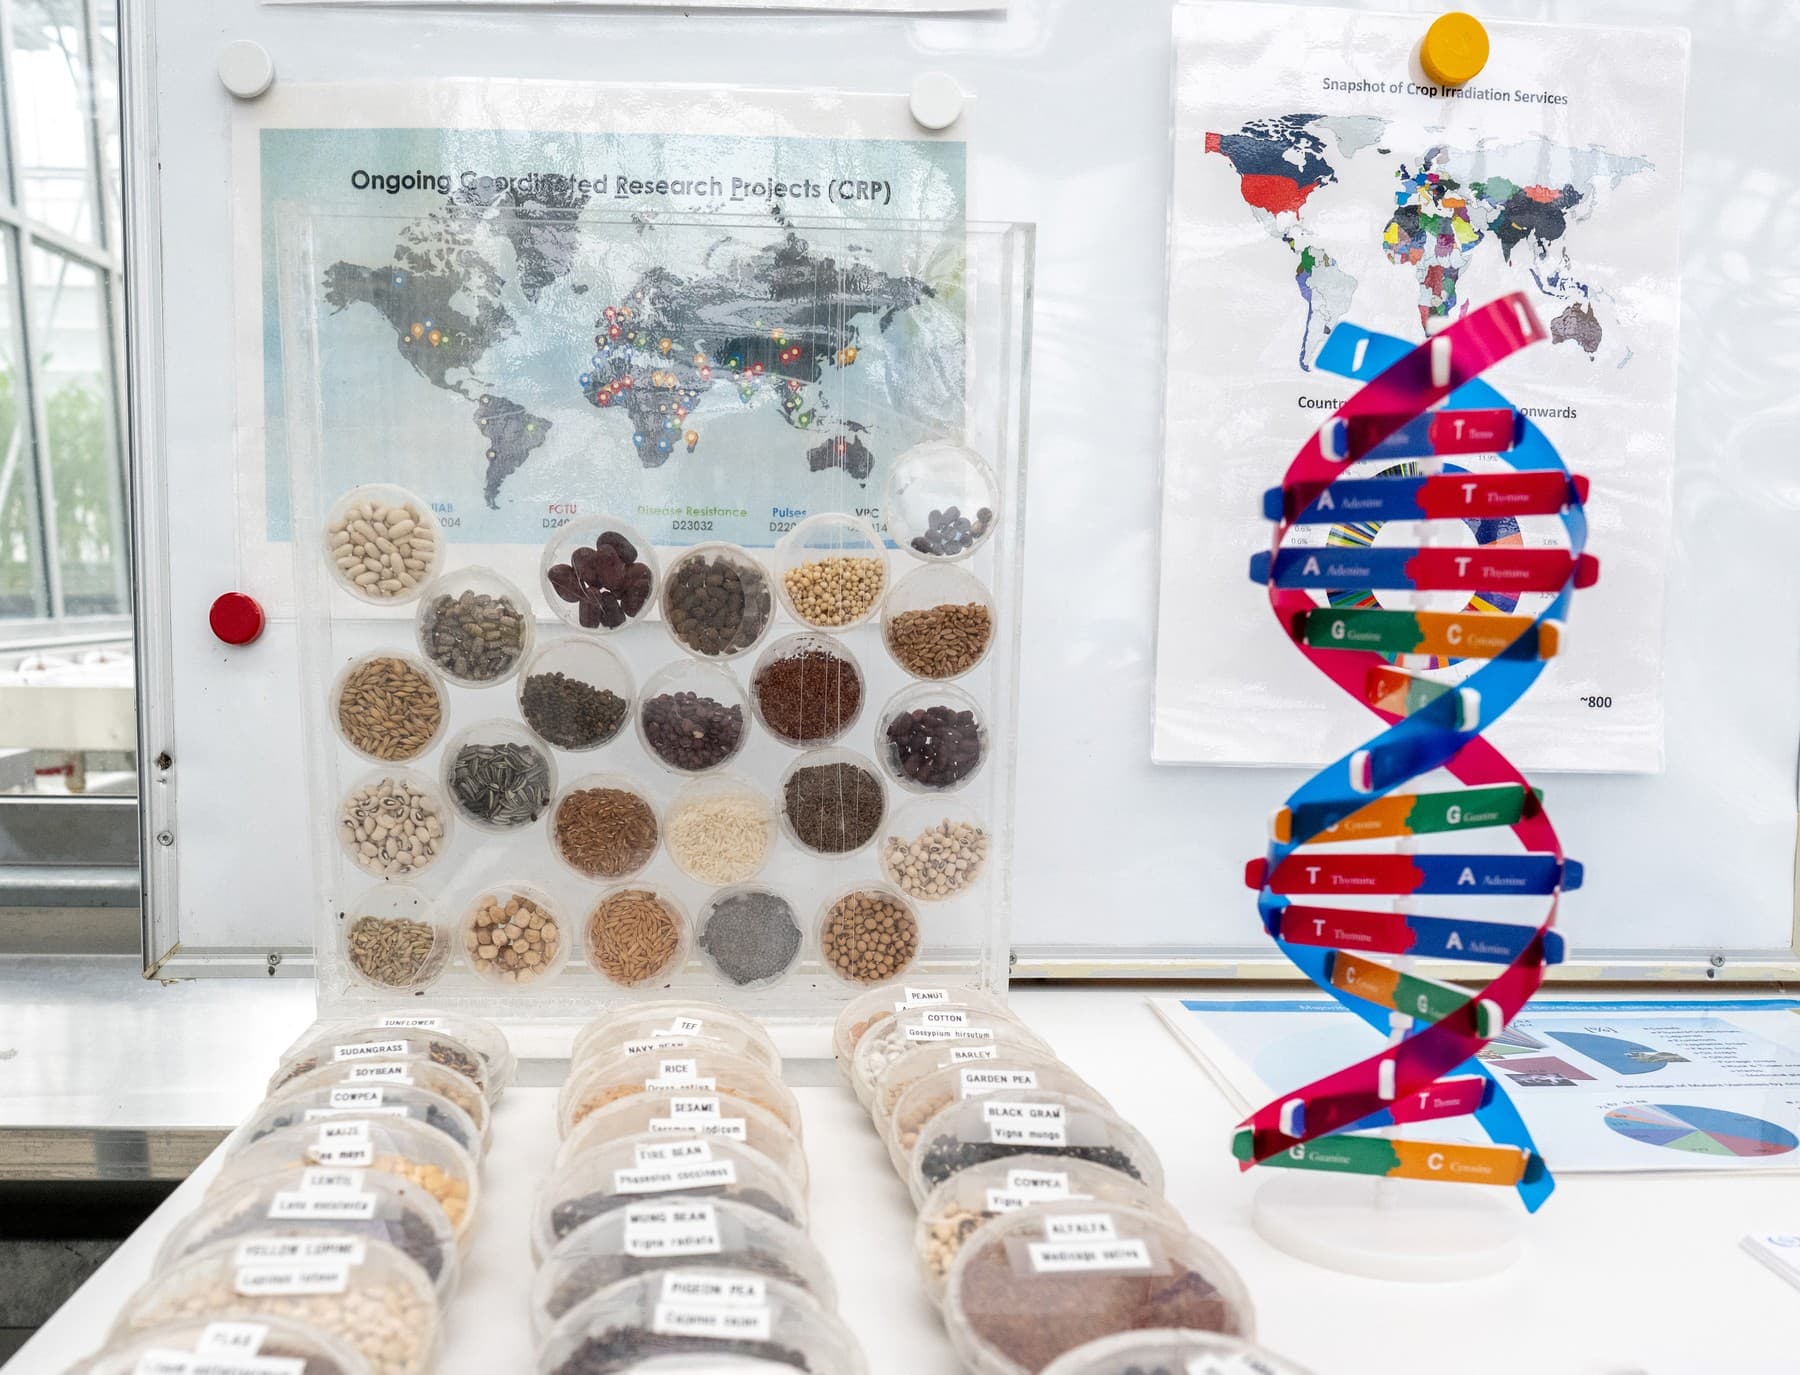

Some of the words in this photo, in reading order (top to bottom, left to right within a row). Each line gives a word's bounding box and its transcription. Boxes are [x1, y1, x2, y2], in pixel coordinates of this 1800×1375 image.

[1323, 77, 1386, 94] Snapshot
[1389, 80, 1404, 94] of
[1407, 82, 1437, 98] Crop
[1441, 84, 1510, 102] Irradiation
[1514, 89, 1568, 105] Services
[352, 170, 451, 195] Ongoing
[614, 176, 722, 198] Research
[730, 177, 821, 201] Projects
[828, 180, 891, 205] (CRP)
[1521, 406, 1577, 419] onwards
[1453, 420, 1465, 440] T
[1317, 490, 1335, 511] A
[1461, 484, 1478, 504] T
[686, 506, 748, 518] Resistance
[772, 507, 807, 518] Pulses
[672, 520, 714, 531] D23032
[1302, 556, 1321, 577] A
[1454, 557, 1472, 578] T
[1331, 621, 1345, 640] G
[1447, 624, 1463, 646] C
[1580, 695, 1612, 709] ~800
[1446, 805, 1462, 825] G
[1306, 866, 1321, 884] T
[1457, 867, 1477, 886] A
[1313, 919, 1326, 936] T
[1446, 931, 1463, 950] A
[911, 992, 944, 1000] PEANUT
[1346, 967, 1356, 984] C
[1416, 995, 1429, 1014] G
[927, 1014, 962, 1022] COTTON
[681, 1021, 698, 1030] TEF
[909, 1029, 951, 1040] Gossypium
[955, 1030, 990, 1040] hirsutum
[340, 1044, 403, 1056] SUDANGRASS
[628, 1044, 654, 1054] NAVY
[955, 1051, 991, 1059] BARLEY
[356, 1066, 402, 1076] SOYBEAN
[665, 1064, 689, 1073] RICE
[966, 1074, 1008, 1083] GARDEN
[1012, 1075, 1032, 1084] PEA
[334, 1092, 378, 1101] COWPEA
[1418, 1092, 1430, 1110] T
[675, 1103, 714, 1112] SESAME
[988, 1107, 1023, 1117] BLACK
[1029, 1109, 1060, 1119] GRAM
[995, 1128, 1023, 1139] Vigna
[1289, 1143, 1305, 1160] G
[1427, 1153, 1444, 1171] C
[1014, 1177, 1061, 1188] COWPEA
